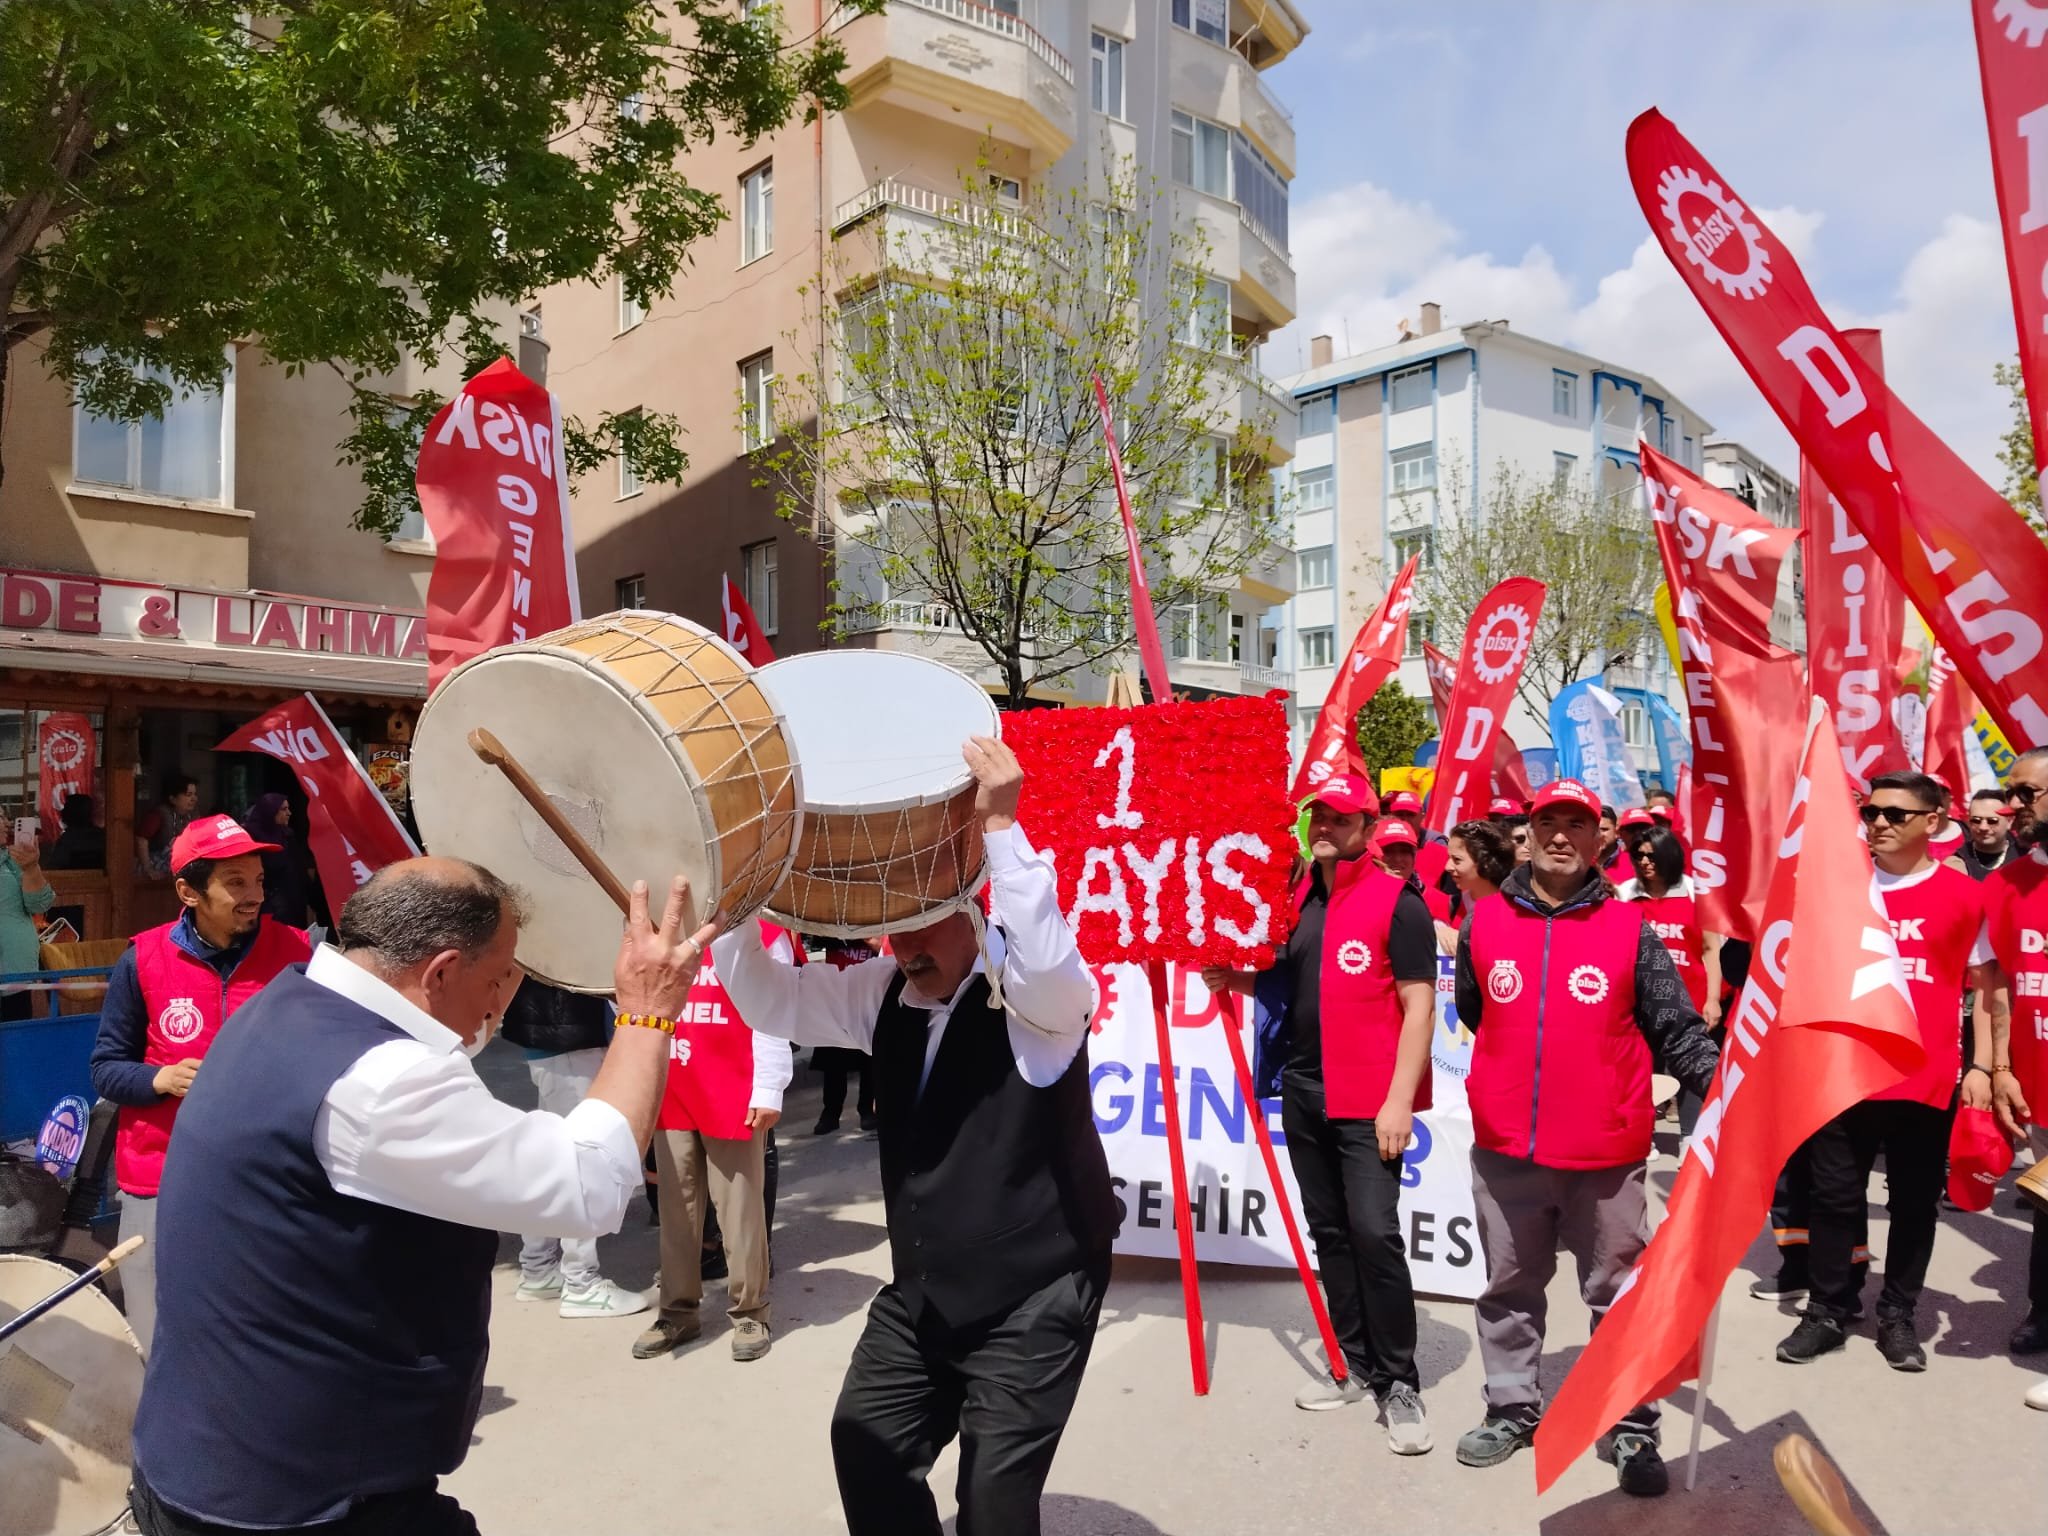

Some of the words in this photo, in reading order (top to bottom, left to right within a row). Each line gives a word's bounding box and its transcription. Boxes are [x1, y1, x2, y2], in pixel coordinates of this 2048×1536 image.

[1692, 211, 1735, 258] DİSK
[138, 596, 182, 638] &
[1484, 631, 1517, 651] DİSK
[1096, 727, 1142, 829] 1
[1040, 831, 1272, 948] AYIS
[41, 1119, 80, 1160] KADRO
